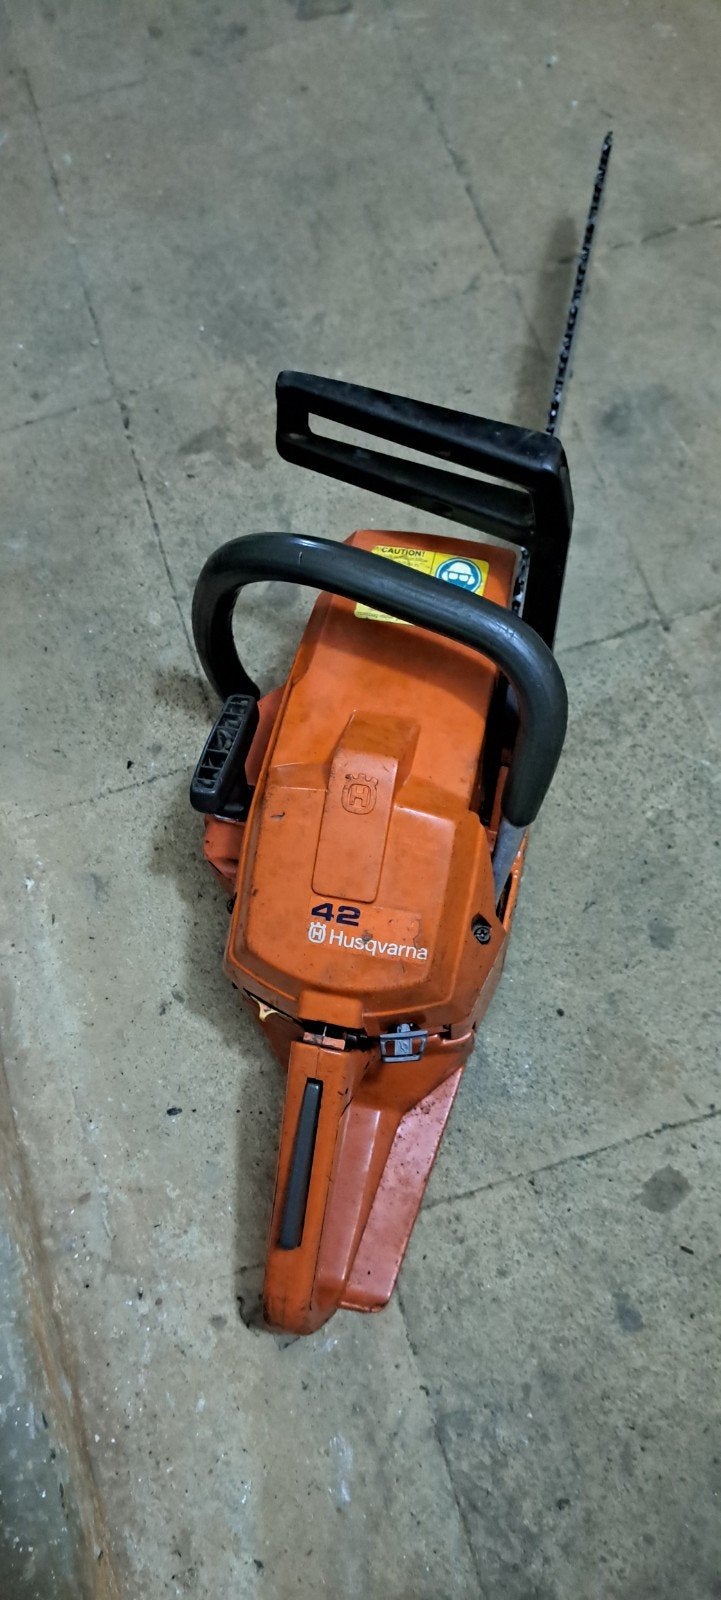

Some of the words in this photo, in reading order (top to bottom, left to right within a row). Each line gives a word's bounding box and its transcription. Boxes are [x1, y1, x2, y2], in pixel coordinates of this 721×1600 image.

[381, 547, 425, 558] CAUTION!
[311, 902, 361, 927] 42
[329, 929, 428, 960] Husqvarna
